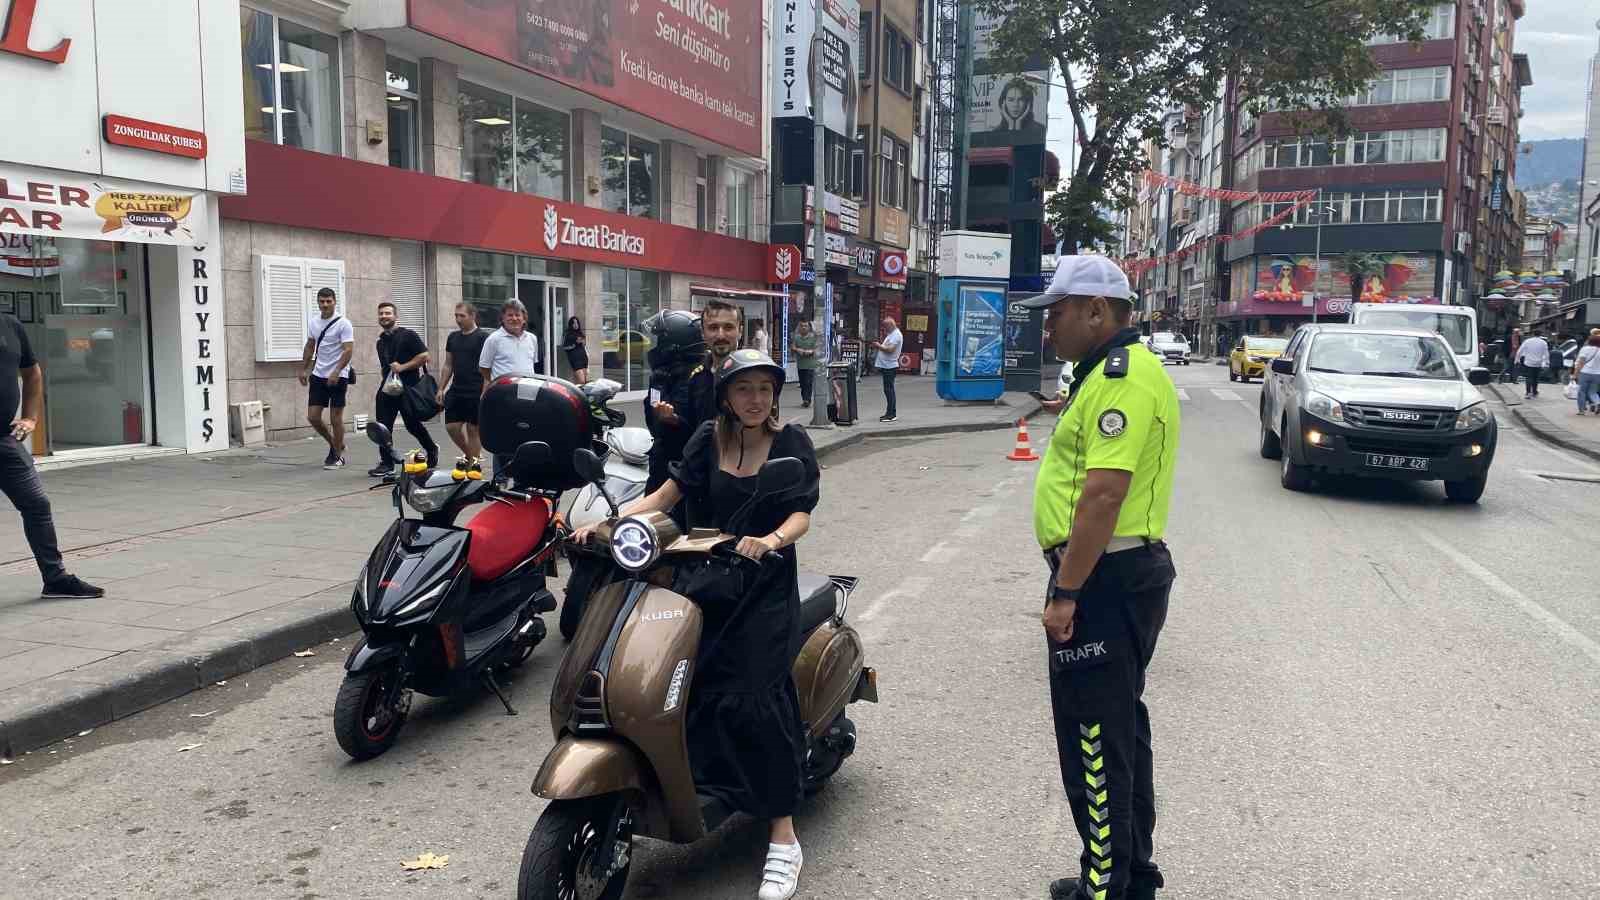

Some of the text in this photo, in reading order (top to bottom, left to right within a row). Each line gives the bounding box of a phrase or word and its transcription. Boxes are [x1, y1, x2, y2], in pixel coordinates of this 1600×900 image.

[663, 0, 730, 39] ankkart
[656, 11, 730, 72] Seni düşünür o
[620, 49, 646, 81] Kredi
[647, 62, 667, 89] kartı
[668, 78, 679, 95] ve
[680, 76, 704, 105] banka
[971, 82, 995, 97] VIP
[114, 124, 202, 150] ZONGULDAK ŞUBESİ
[110, 192, 182, 203] HER ZAMAN
[113, 200, 180, 212] KALİTELİ
[0, 208, 63, 231] AR
[129, 214, 174, 224] ÜRÜNLER
[560, 217, 645, 256] Ziraat Bankası
[191, 245, 215, 442] RUYEMİŞ
[1383, 410, 1420, 421] ISUZU
[642, 610, 682, 622] KUBA
